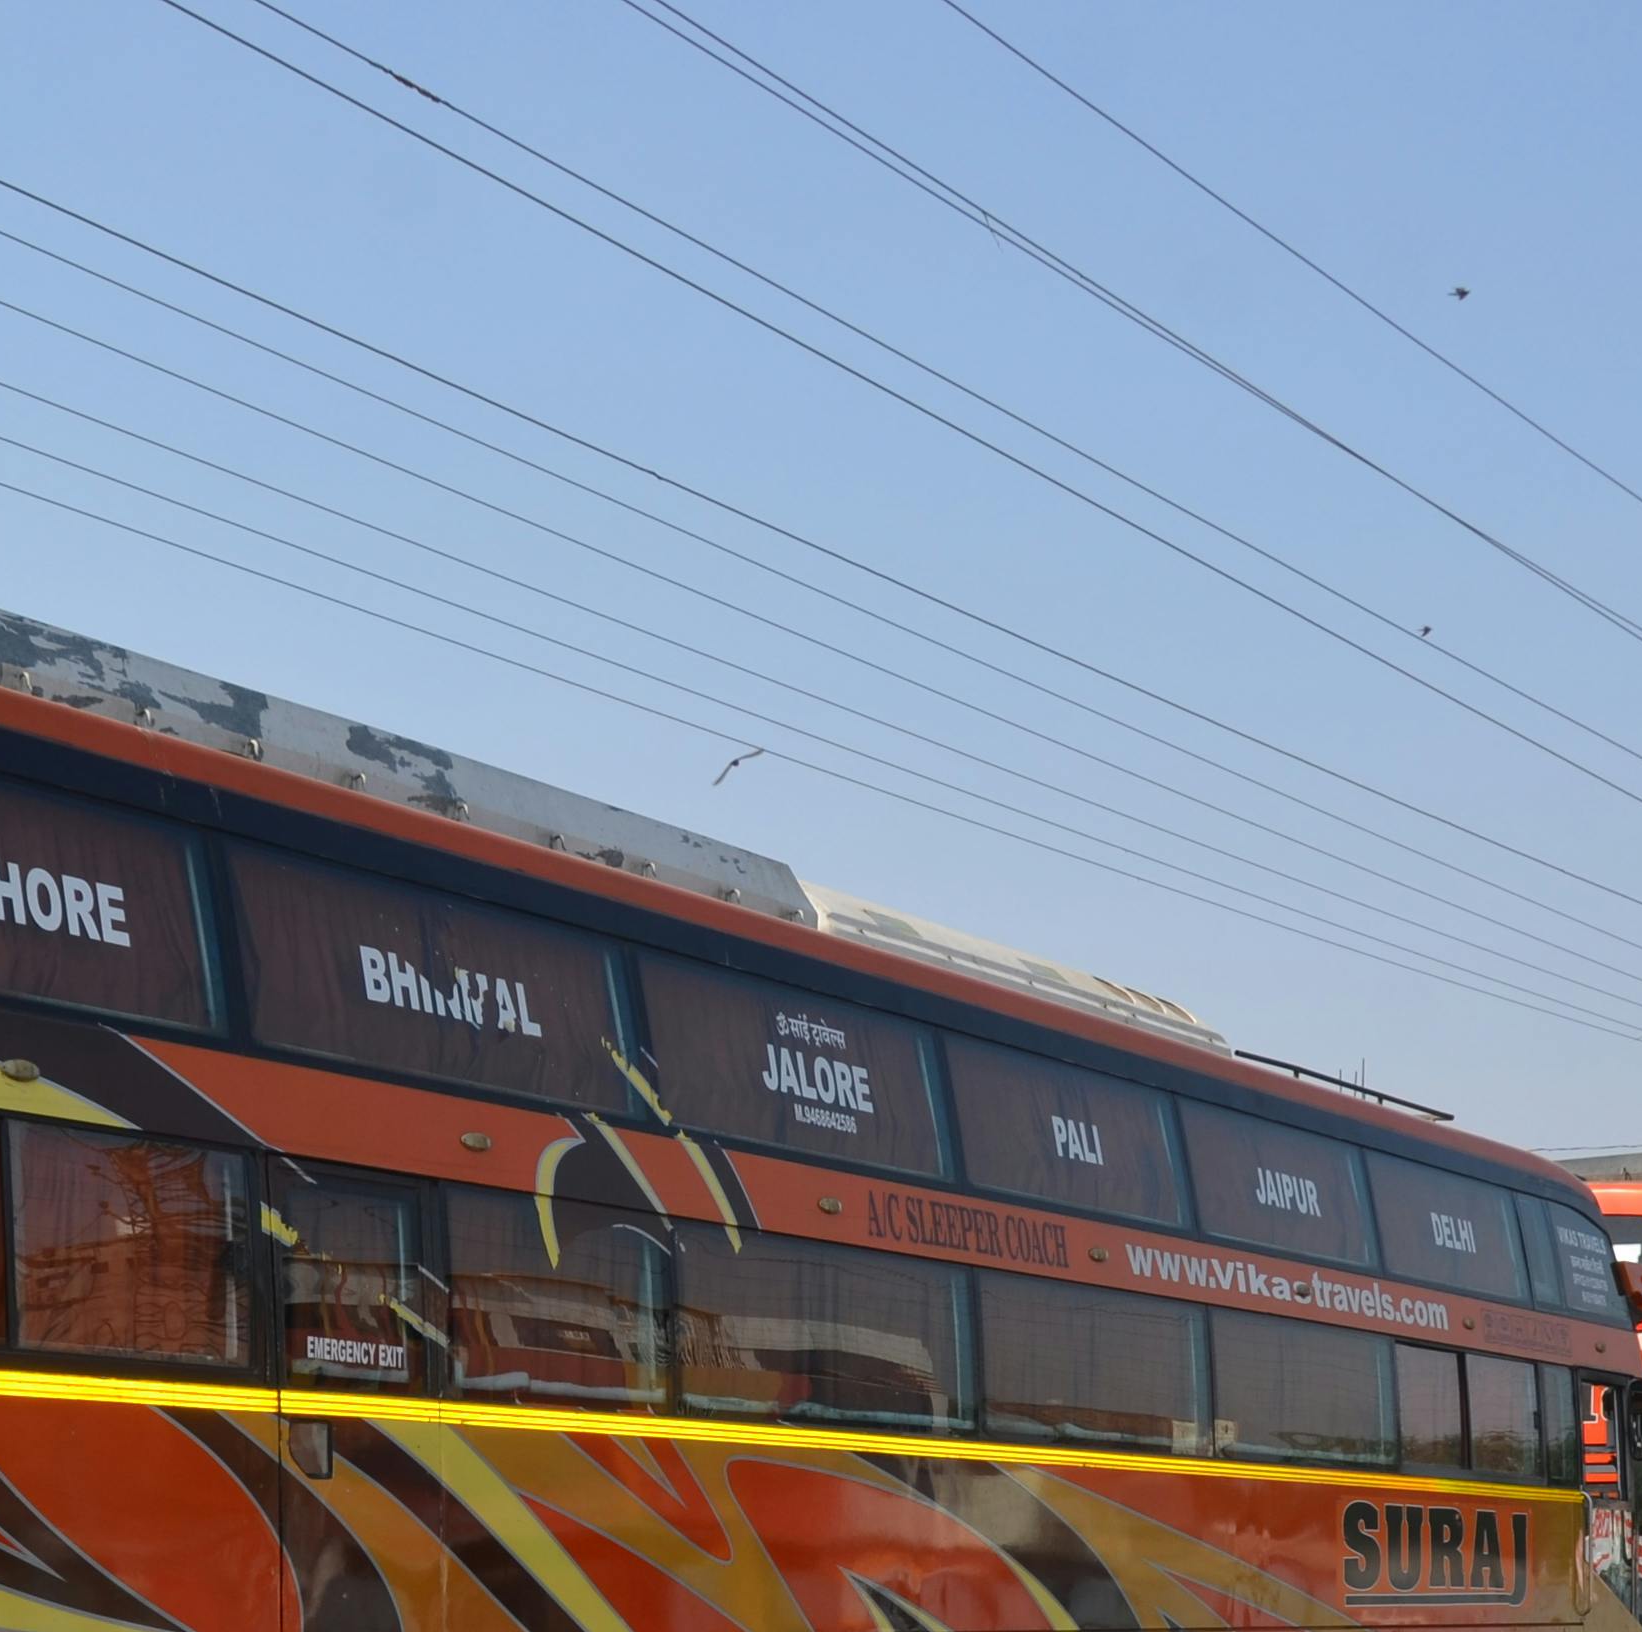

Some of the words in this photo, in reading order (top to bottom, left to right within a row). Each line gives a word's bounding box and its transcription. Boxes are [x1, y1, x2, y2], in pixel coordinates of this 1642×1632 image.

[762, 1043, 874, 1114] JALORE
[1051, 1115, 1104, 1167] PALI
[1256, 1167, 1322, 1218] JAIPUR
[906, 1196, 1004, 1259] SLEEPER
[1006, 1214, 1070, 1269] COACH
[1430, 1212, 1477, 1255] DELHI
[305, 1335, 376, 1367] EMERGENCY
[378, 1343, 404, 1370] EXIT
[1342, 1500, 1528, 1607] SURAJ
